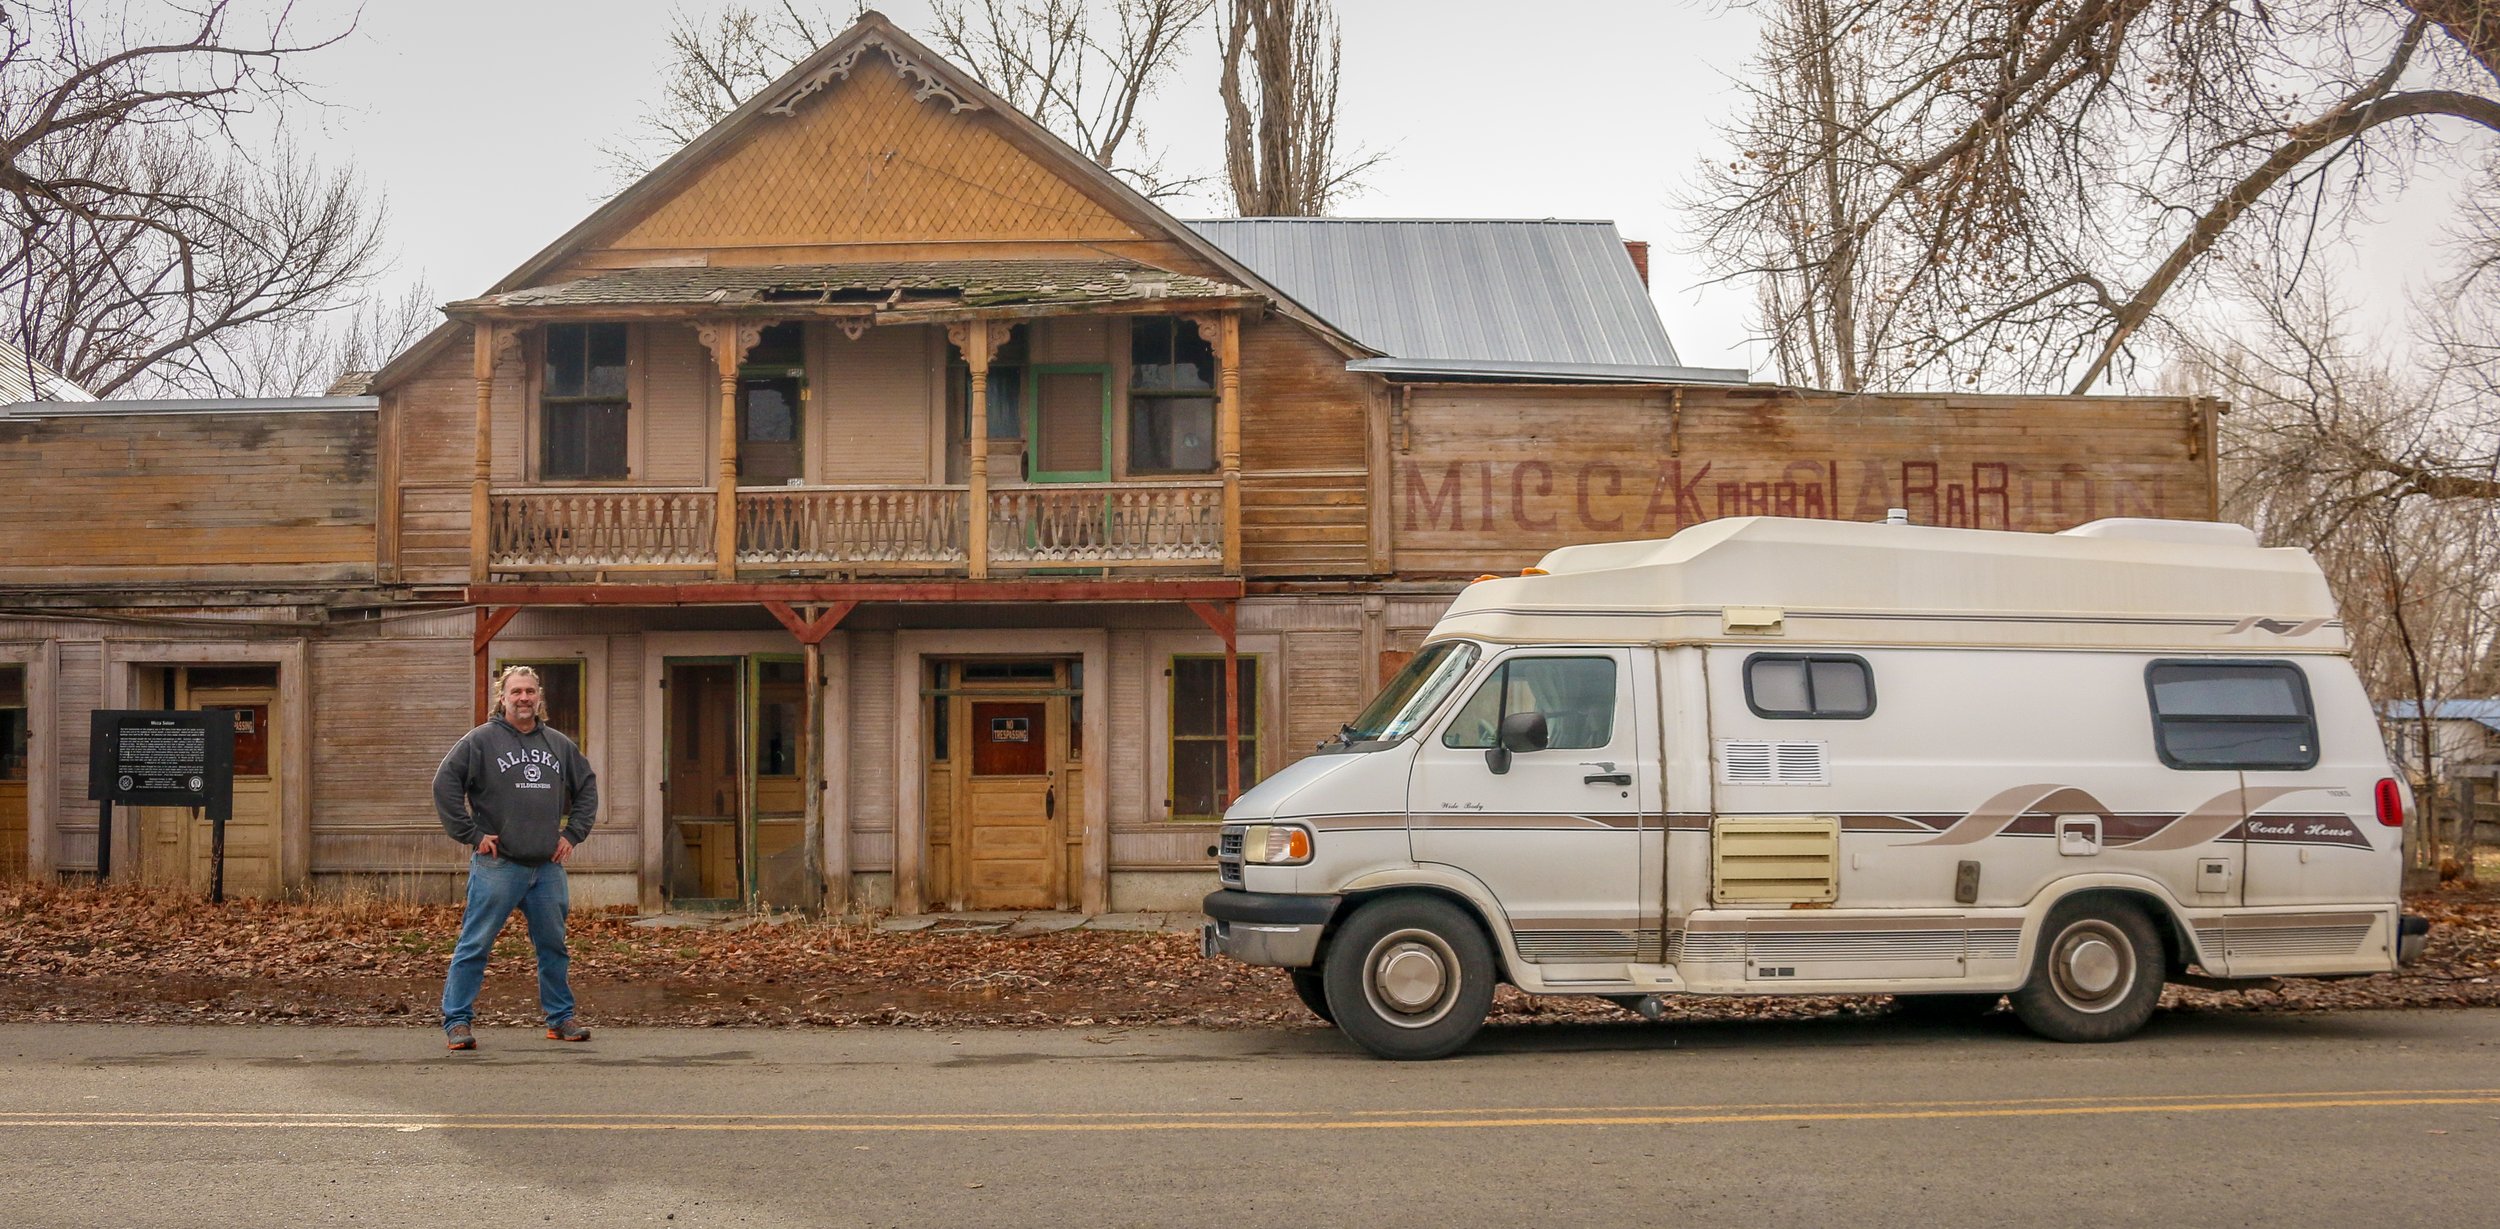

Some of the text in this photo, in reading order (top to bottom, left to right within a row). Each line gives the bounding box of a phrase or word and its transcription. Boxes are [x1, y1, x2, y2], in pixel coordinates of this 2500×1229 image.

[1401, 459, 1694, 532] MICCA
[1006, 720, 1013, 729] NO
[994, 730, 1026, 739] TRESPASSING
[496, 748, 561, 774] ALASKA
[1464, 802, 1483, 811] Body
[2247, 820, 2353, 838] Coach House
